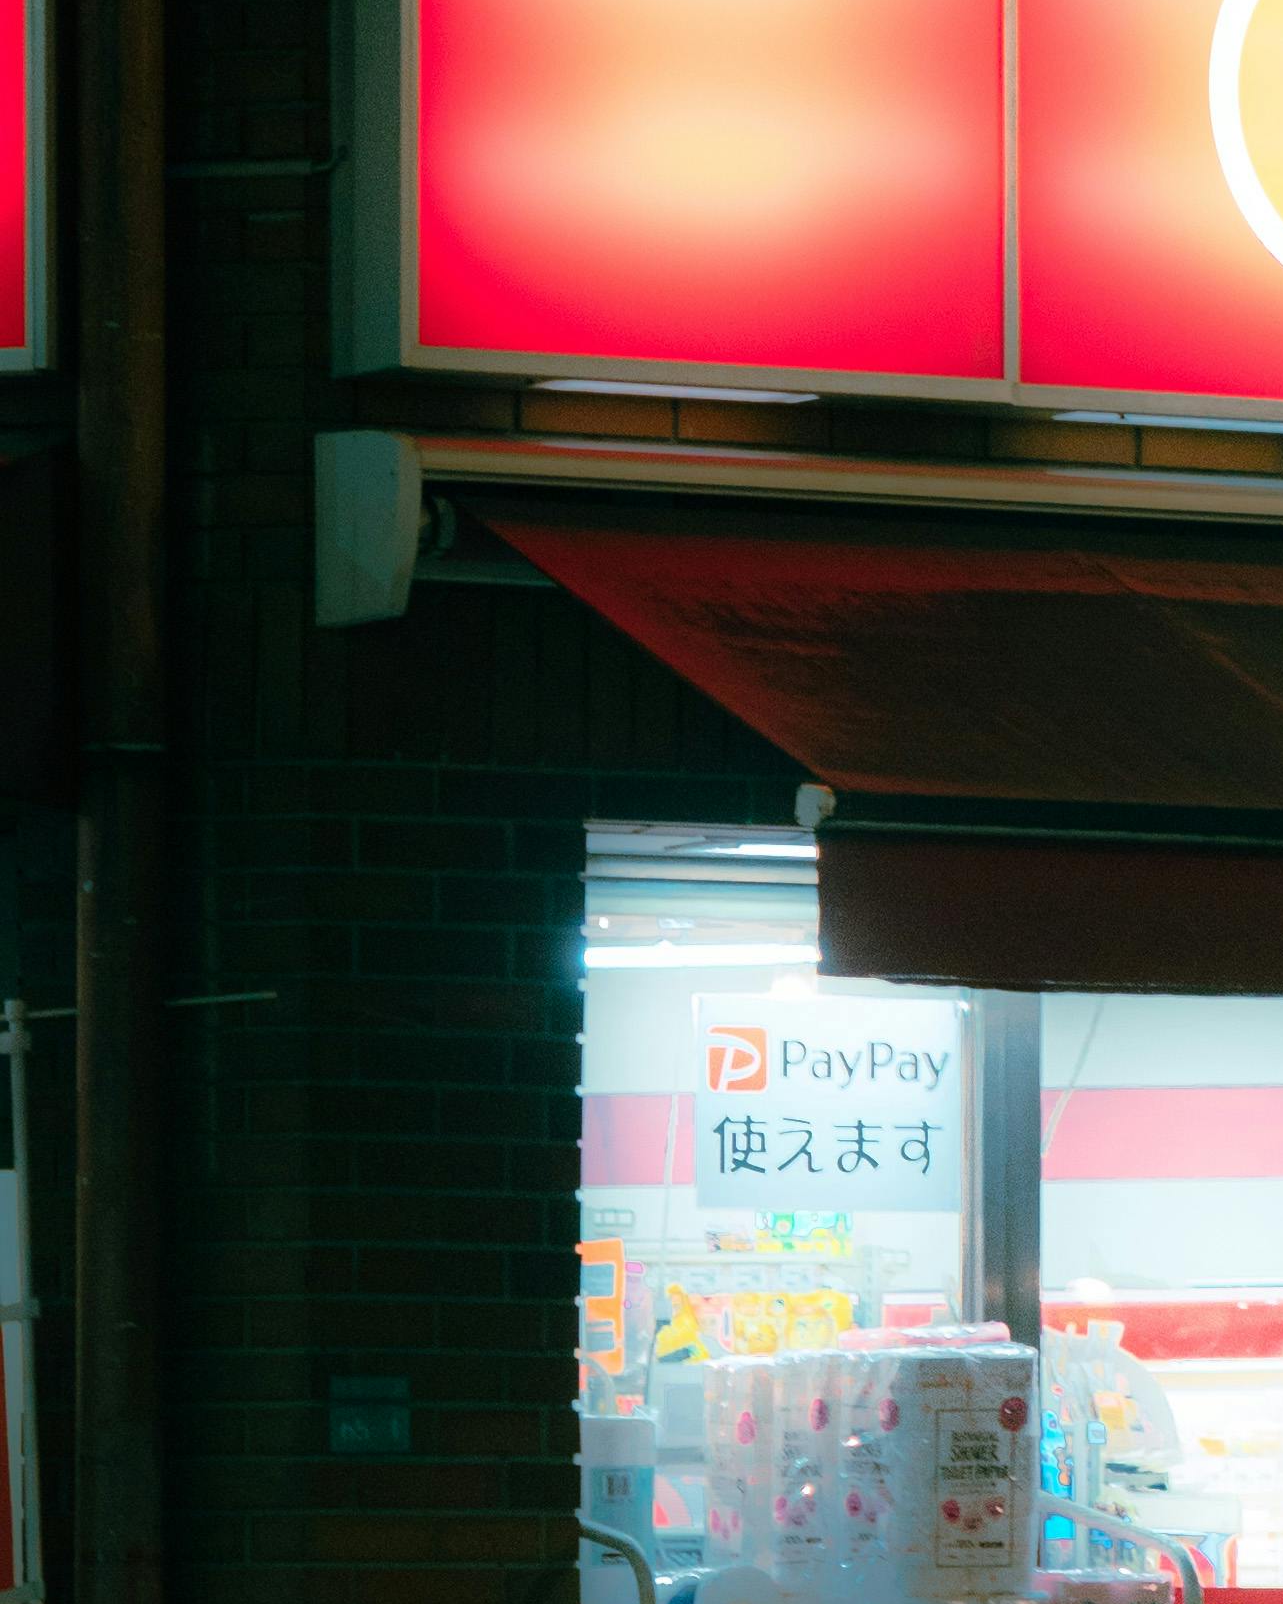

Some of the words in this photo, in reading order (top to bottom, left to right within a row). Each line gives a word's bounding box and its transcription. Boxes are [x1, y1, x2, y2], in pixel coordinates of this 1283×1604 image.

[779, 1039, 950, 1091] PayPay
[713, 1114, 945, 1175] 使えます
